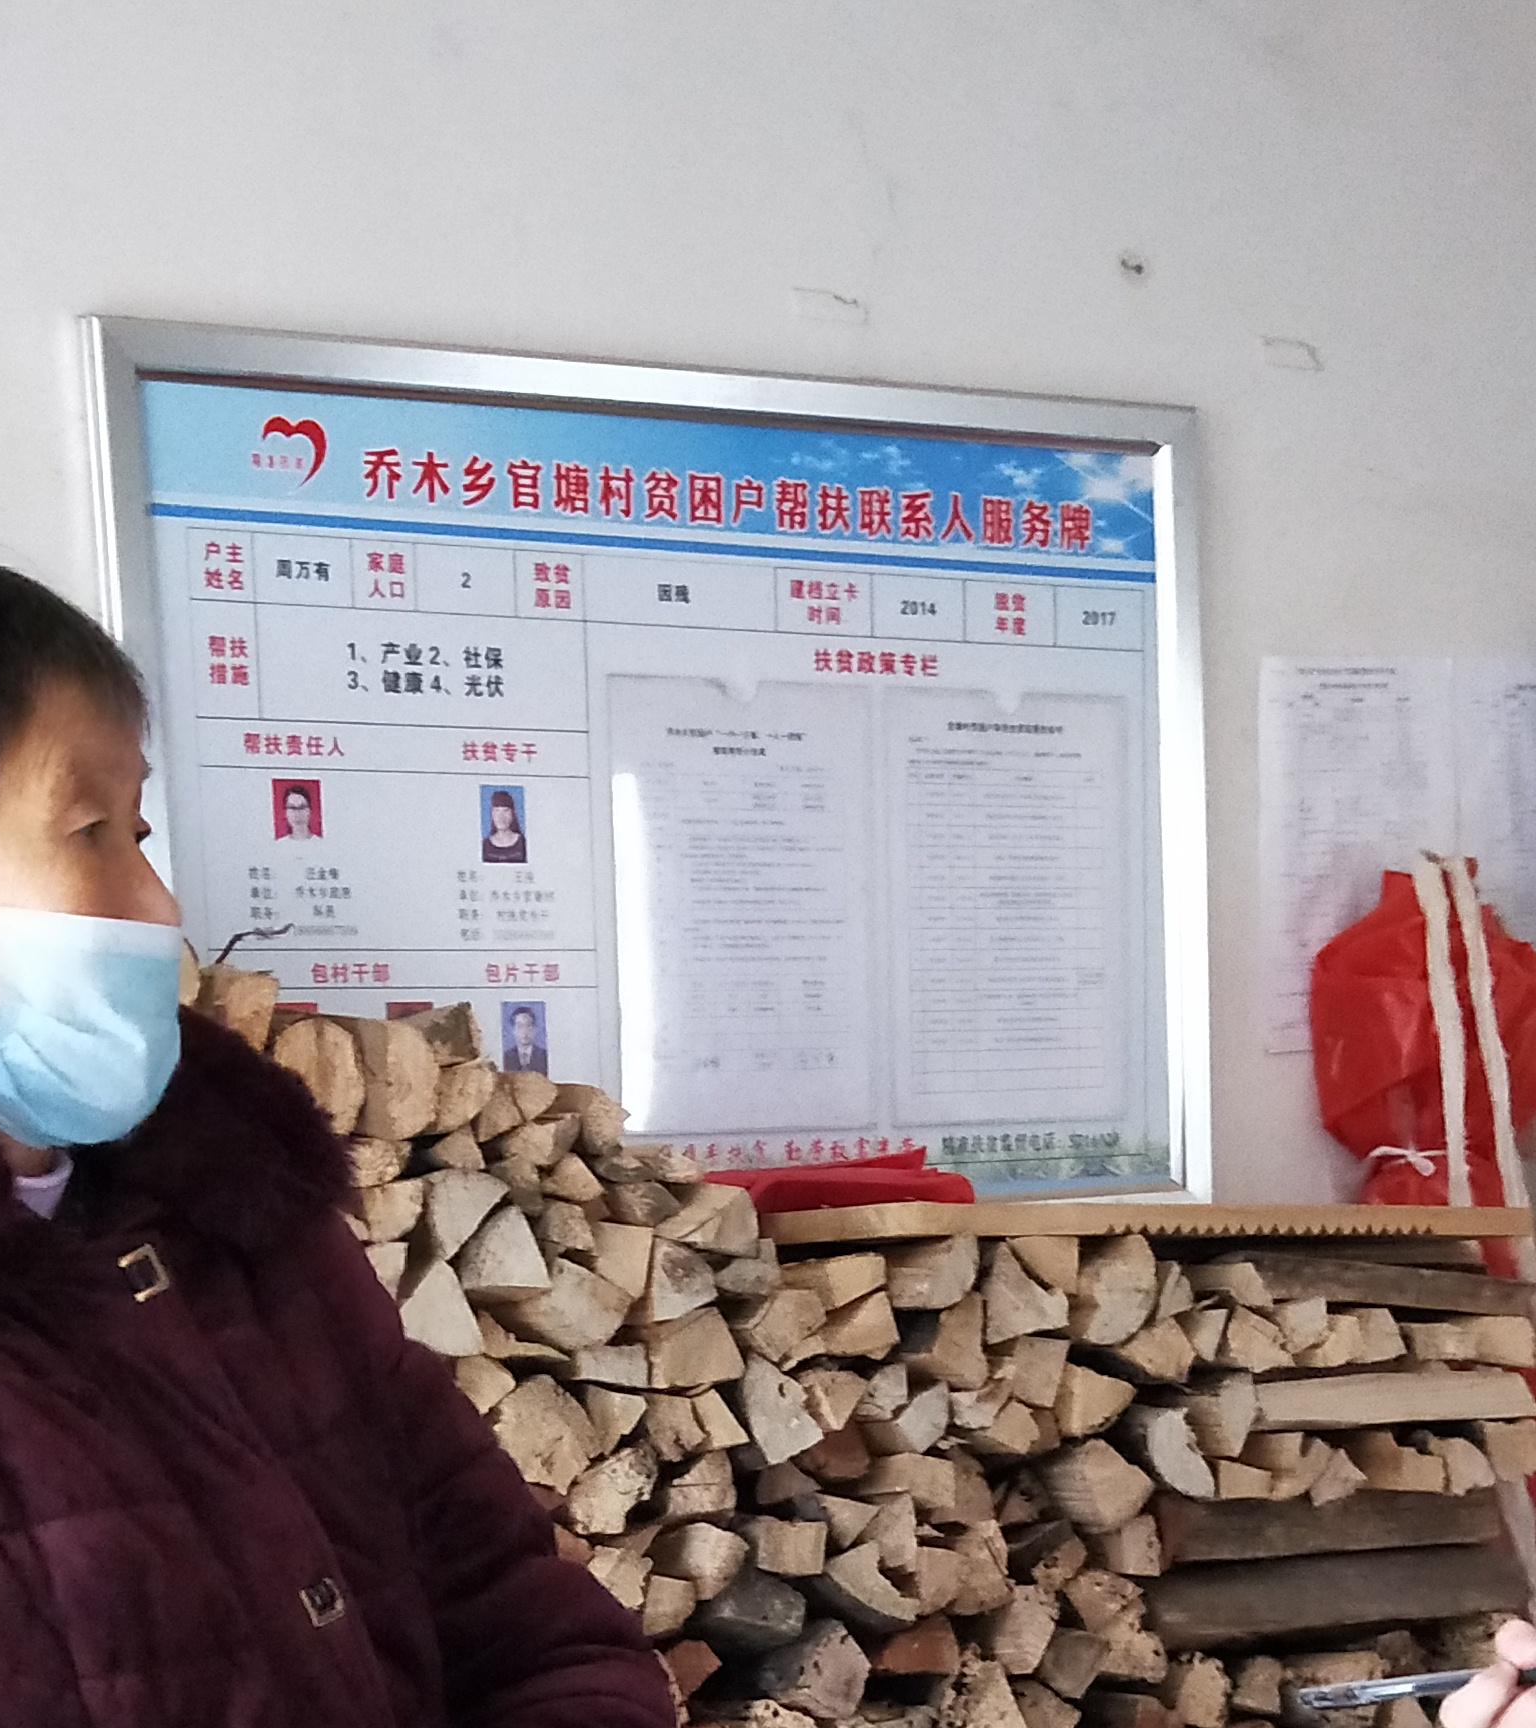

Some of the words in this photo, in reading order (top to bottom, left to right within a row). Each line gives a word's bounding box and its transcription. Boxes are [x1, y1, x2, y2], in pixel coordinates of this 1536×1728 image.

[362, 447, 1096, 553] 乔木乡官塘村贫困户帮扶联系人服务牌
[204, 541, 245, 565] 户主
[366, 552, 406, 576] 家庭
[204, 568, 245, 591] 姓名
[461, 573, 471, 589] 2
[533, 562, 570, 584] 致贫
[368, 579, 406, 599] 人口
[534, 588, 572, 610] 原因
[807, 605, 842, 626] 时间
[900, 600, 938, 617] 2014
[1082, 611, 1116, 627] 2017
[208, 636, 249, 659] 帮扶
[814, 648, 940, 678] 扶贫政策专栏
[209, 663, 251, 687] 措施
[243, 731, 345, 759] 帮扶责任人
[462, 741, 538, 764] 扶贫专干
[311, 962, 391, 984] 包村干部
[486, 962, 560, 983] 包片干部
